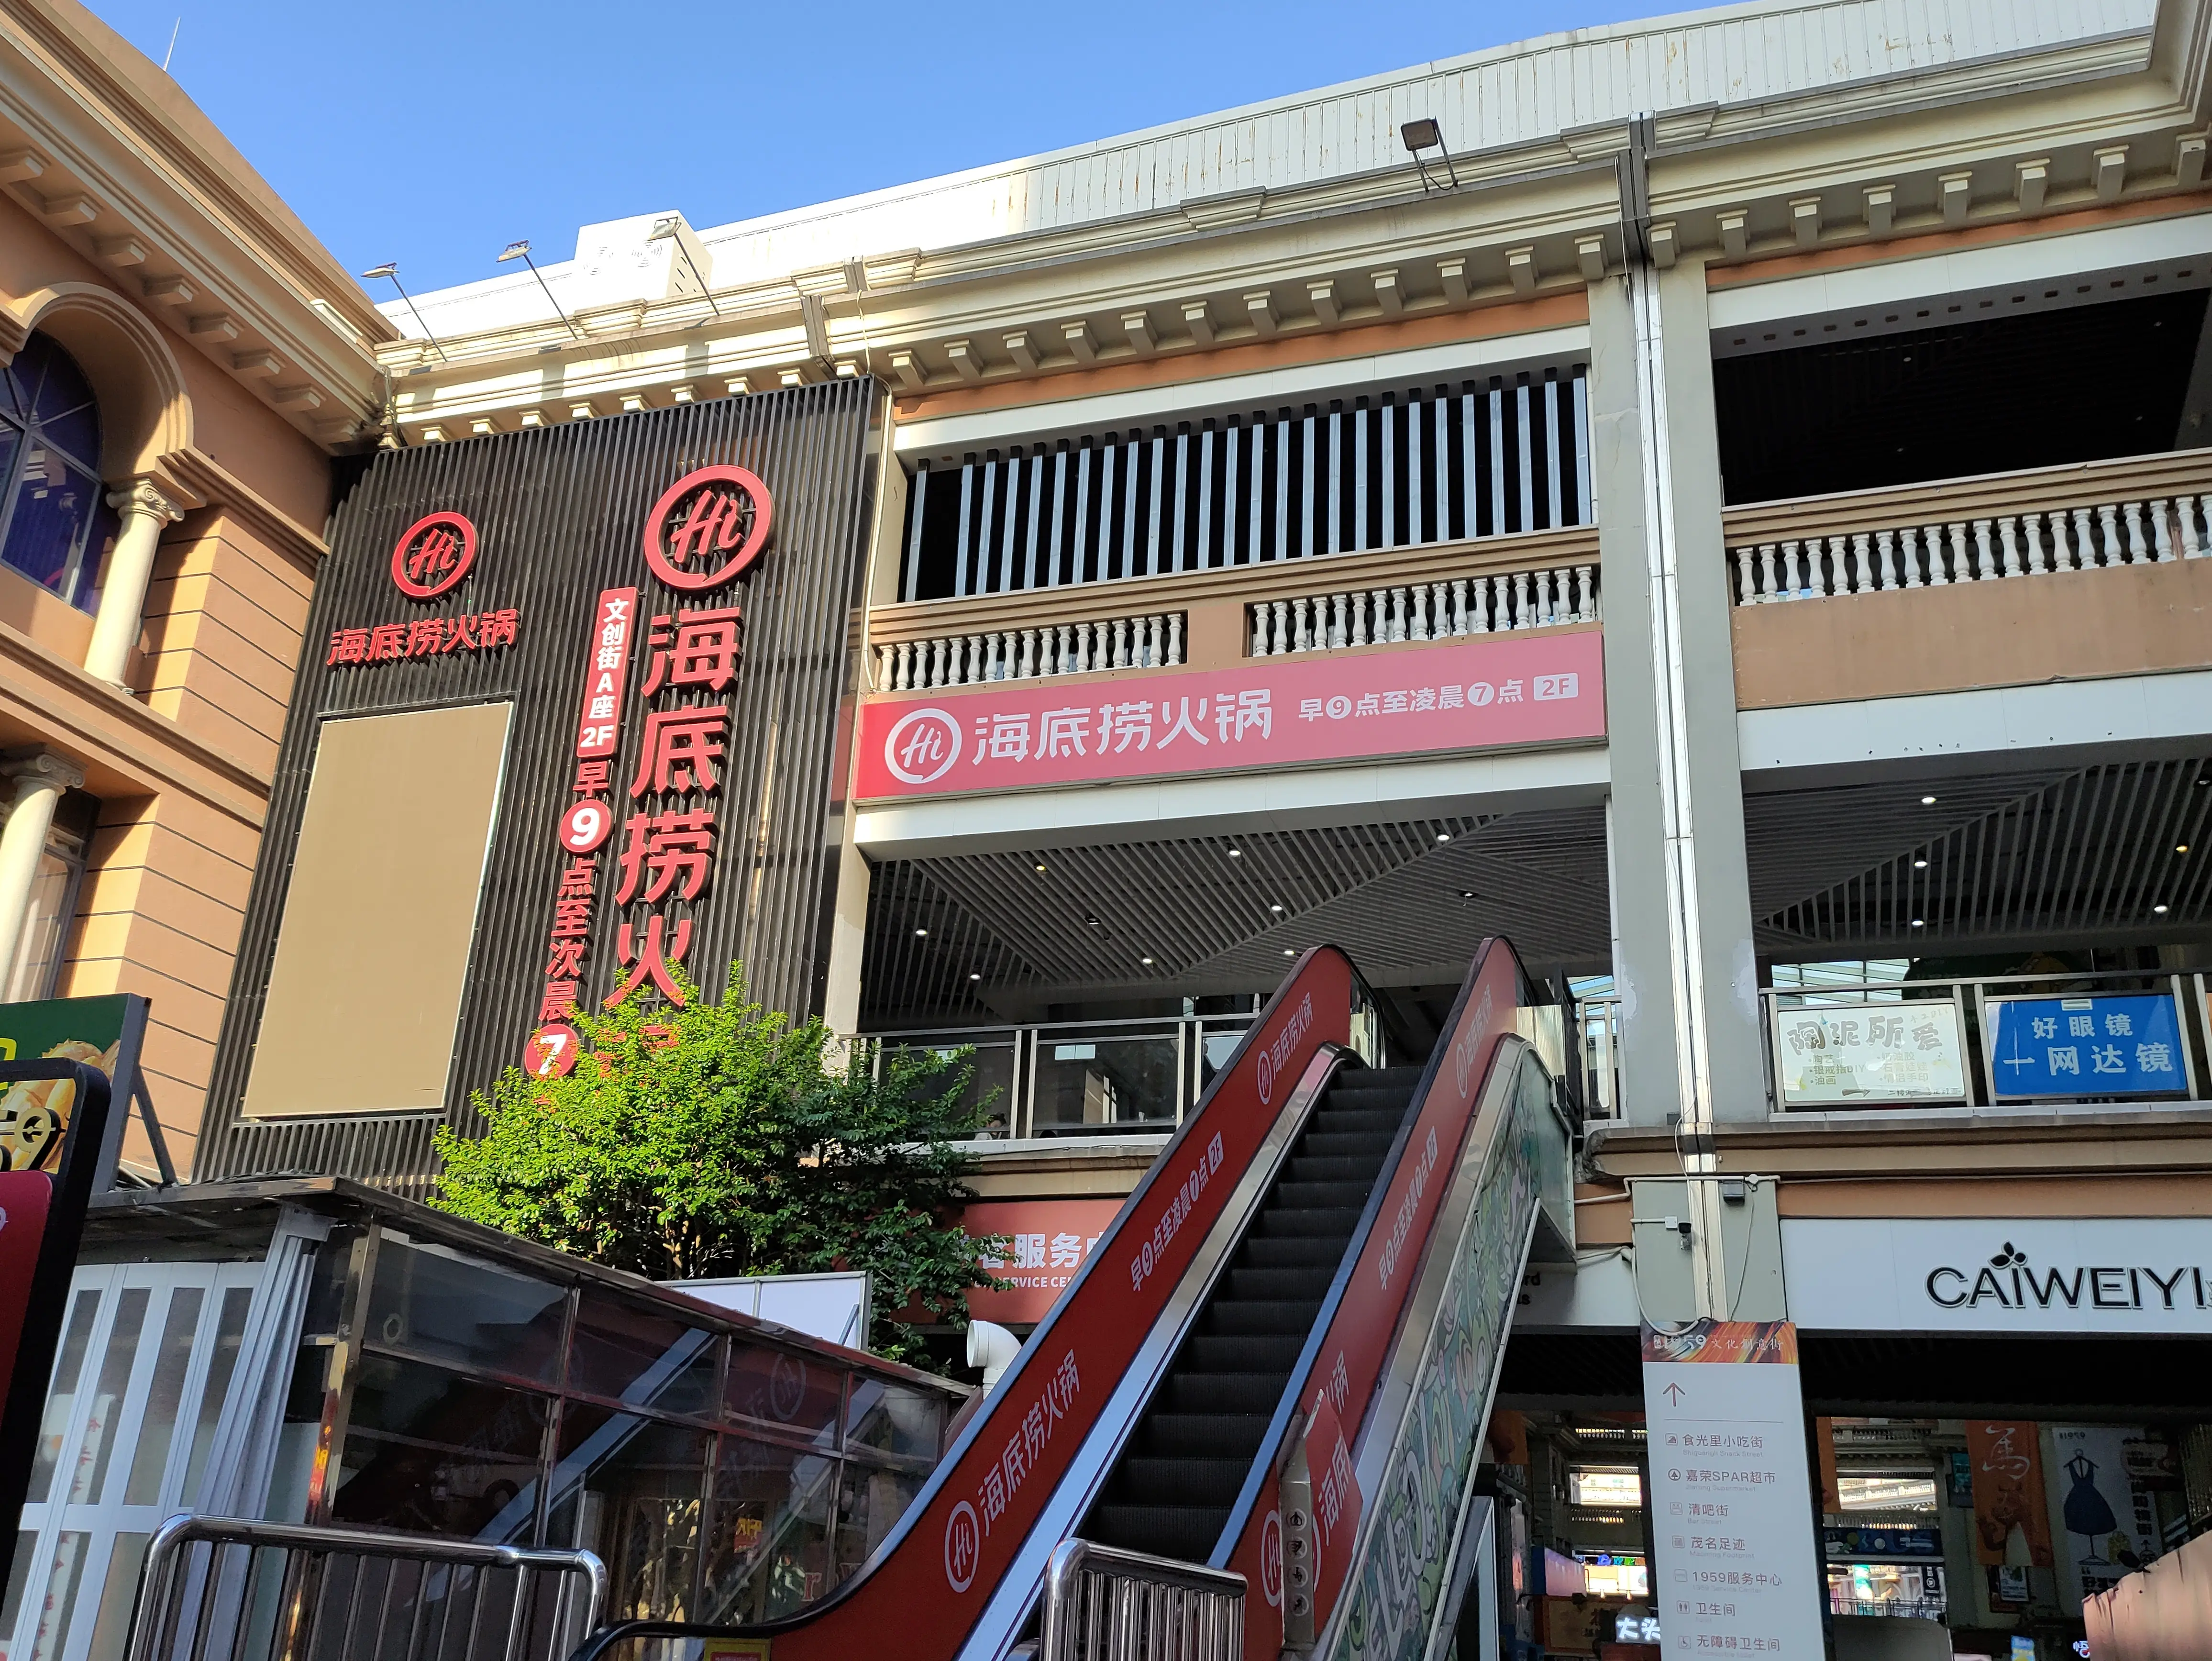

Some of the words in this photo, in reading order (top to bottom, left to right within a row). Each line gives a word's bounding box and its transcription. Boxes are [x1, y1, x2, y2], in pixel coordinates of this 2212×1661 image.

[326, 608, 519, 666] 海底捞火锅
[580, 597, 630, 749] 文创街A座2F
[1298, 678, 1524, 721] 早9点至凌晨7点
[972, 688, 1272, 765] 海底捞火锅
[596, 606, 744, 1082] 海底捞火
[1270, 991, 1313, 1080] 海底捞火锅
[1787, 1015, 1943, 1056] 陶泥所爱
[2031, 1013, 2134, 1040] 好眼镜
[1814, 1075, 1836, 1085] 油画
[977, 1349, 1080, 1537] 海底捞火锅
[1682, 1434, 1763, 1449] 食光里小吃街
[1685, 1469, 1776, 1484] 嘉荣SPAR超市
[1688, 1503, 1729, 1517] 清吧街
[1691, 1536, 1746, 1551] 茂名足迹
[1692, 1571, 1782, 1586] 1959服务中心
[1695, 1602, 1736, 1617] 卫生间
[1696, 1635, 1780, 1651] 无障碍卫生间
